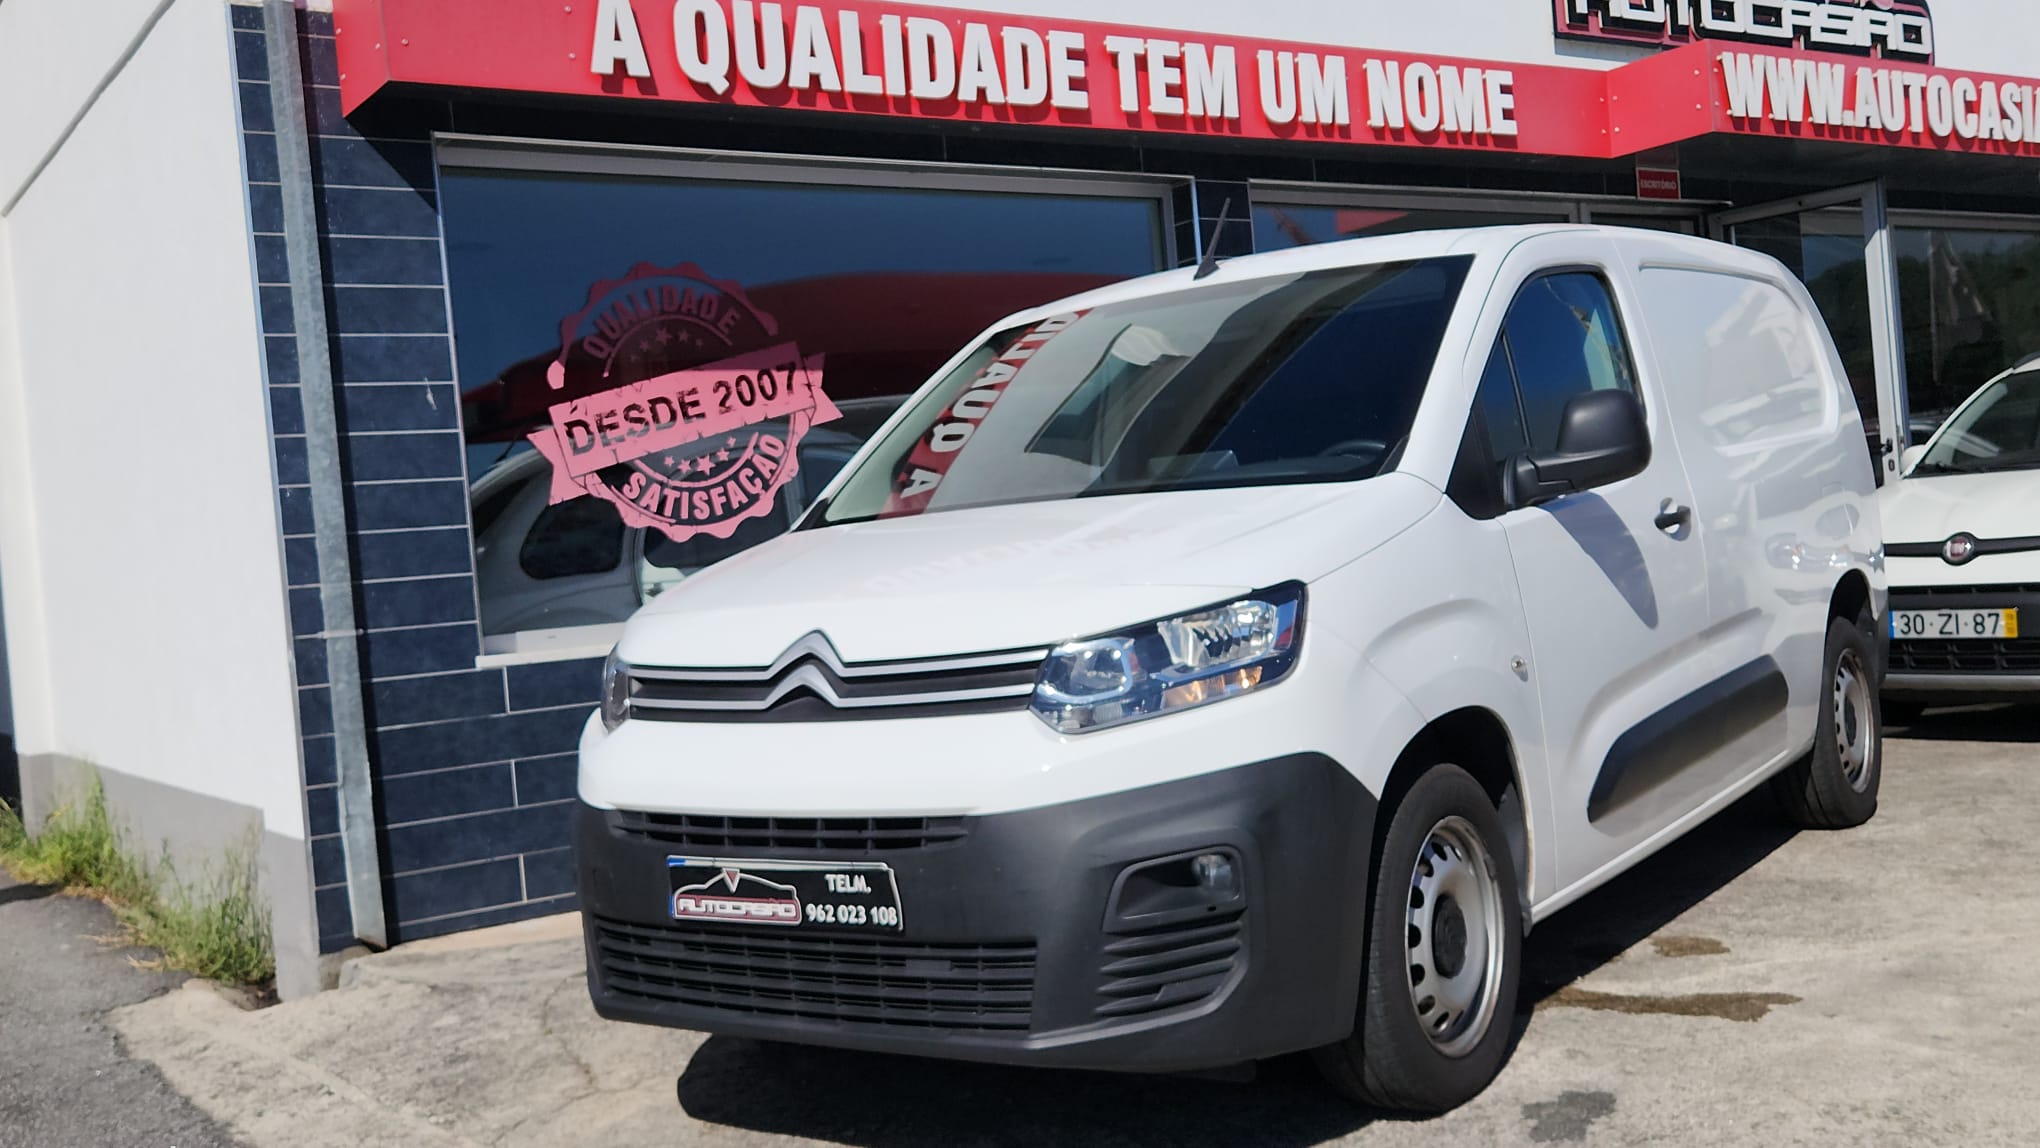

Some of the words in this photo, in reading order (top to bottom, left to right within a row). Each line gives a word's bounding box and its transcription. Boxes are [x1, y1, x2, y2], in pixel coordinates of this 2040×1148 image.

[590, 0, 651, 78] A
[674, 0, 1089, 109] QUALIDADE
[1104, 35, 1240, 119] TEM
[1257, 49, 1351, 126] UM
[1363, 58, 1519, 136] NOME
[1721, 51, 2040, 144] WWW.AUTOCASI
[563, 387, 706, 457] DESDE
[713, 361, 797, 416] 2007
[805, 903, 835, 923] 962
[837, 904, 867, 925] 023
[870, 906, 899, 926] 108
[824, 873, 872, 894] TELM.
